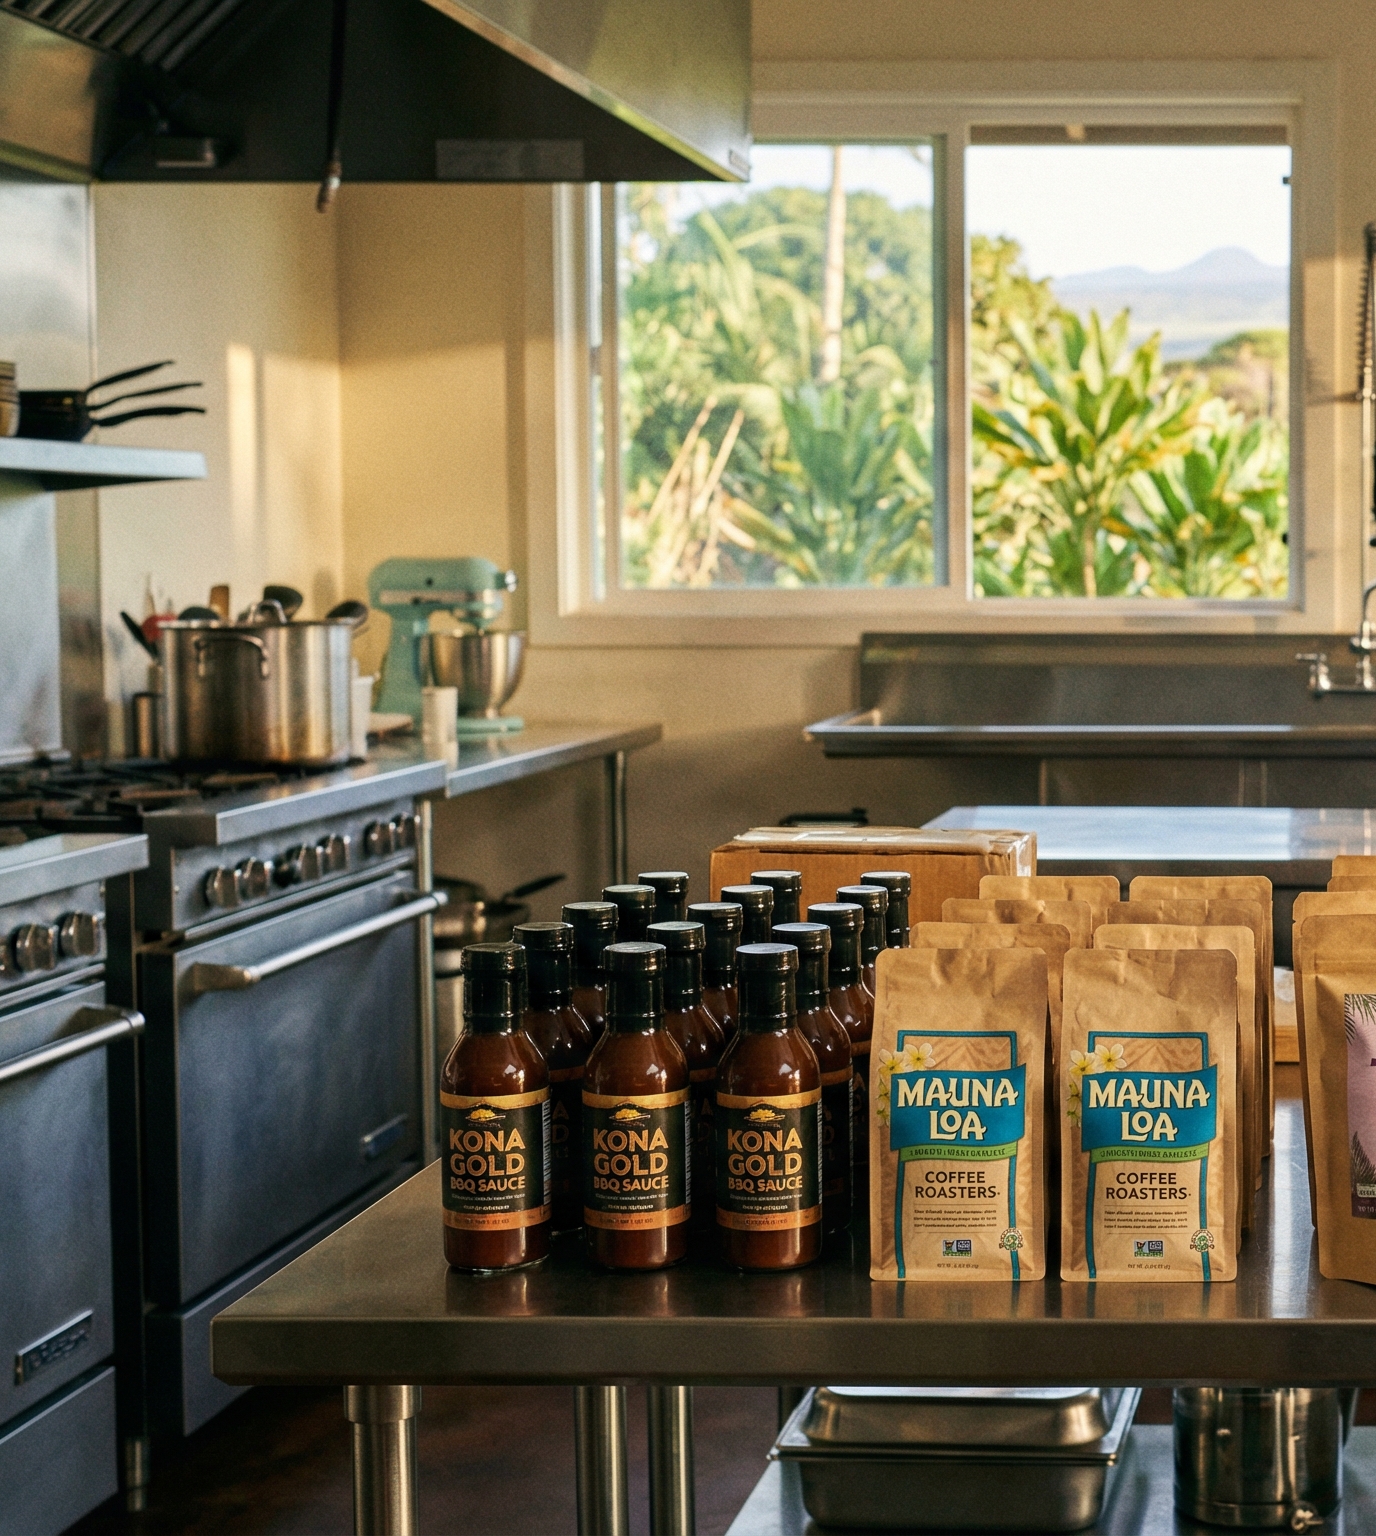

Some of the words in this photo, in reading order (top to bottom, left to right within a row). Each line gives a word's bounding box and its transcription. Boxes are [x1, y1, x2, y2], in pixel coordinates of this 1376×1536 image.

[897, 1077, 1019, 1108] MAUNA
[1088, 1078, 1210, 1109] MAUNA
[929, 1110, 987, 1141] LOA
[1120, 1111, 1178, 1142] LOA
[449, 1127, 526, 1152] KONA
[593, 1127, 669, 1152] KONA
[727, 1127, 803, 1152] KONA
[450, 1153, 525, 1177] GOLD
[593, 1152, 668, 1176] GOLD
[728, 1152, 802, 1176] GOLD
[478, 1175, 525, 1192] SAUCE
[622, 1175, 669, 1192] SAUCE
[757, 1175, 803, 1192] SAUCE
[925, 1171, 985, 1184] COFFEE
[1116, 1172, 1177, 1185] COFFEE
